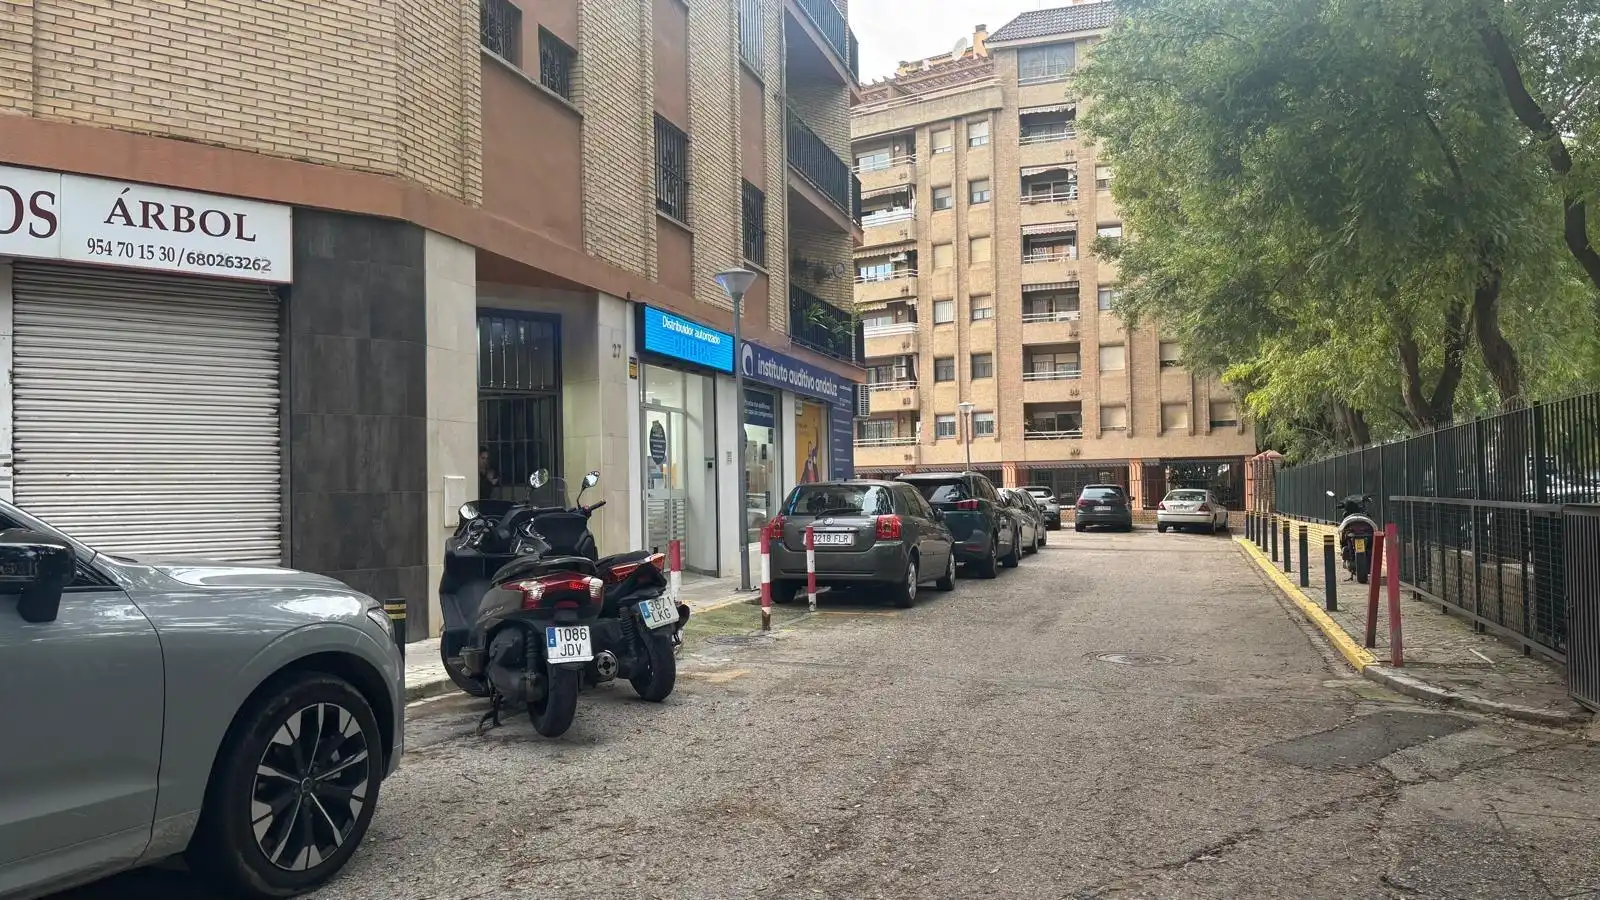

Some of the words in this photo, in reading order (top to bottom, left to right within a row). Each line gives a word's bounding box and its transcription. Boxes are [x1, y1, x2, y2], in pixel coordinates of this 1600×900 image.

[104, 187, 256, 242] ÁRBOL
[87, 237, 112, 257] 954
[117, 241, 134, 258] 70
[138, 244, 155, 261] 15
[662, 315, 694, 337] Distribuidor
[694, 328, 721, 345] autorizado
[612, 343, 622, 359] 27
[757, 353, 788, 382] instituto
[789, 367, 815, 390] auditivo
[815, 376, 838, 397] andaluz
[834, 534, 849, 543] FLR
[651, 608, 671, 623] LKG
[558, 628, 587, 642] 1086
[560, 643, 582, 657] JDV
